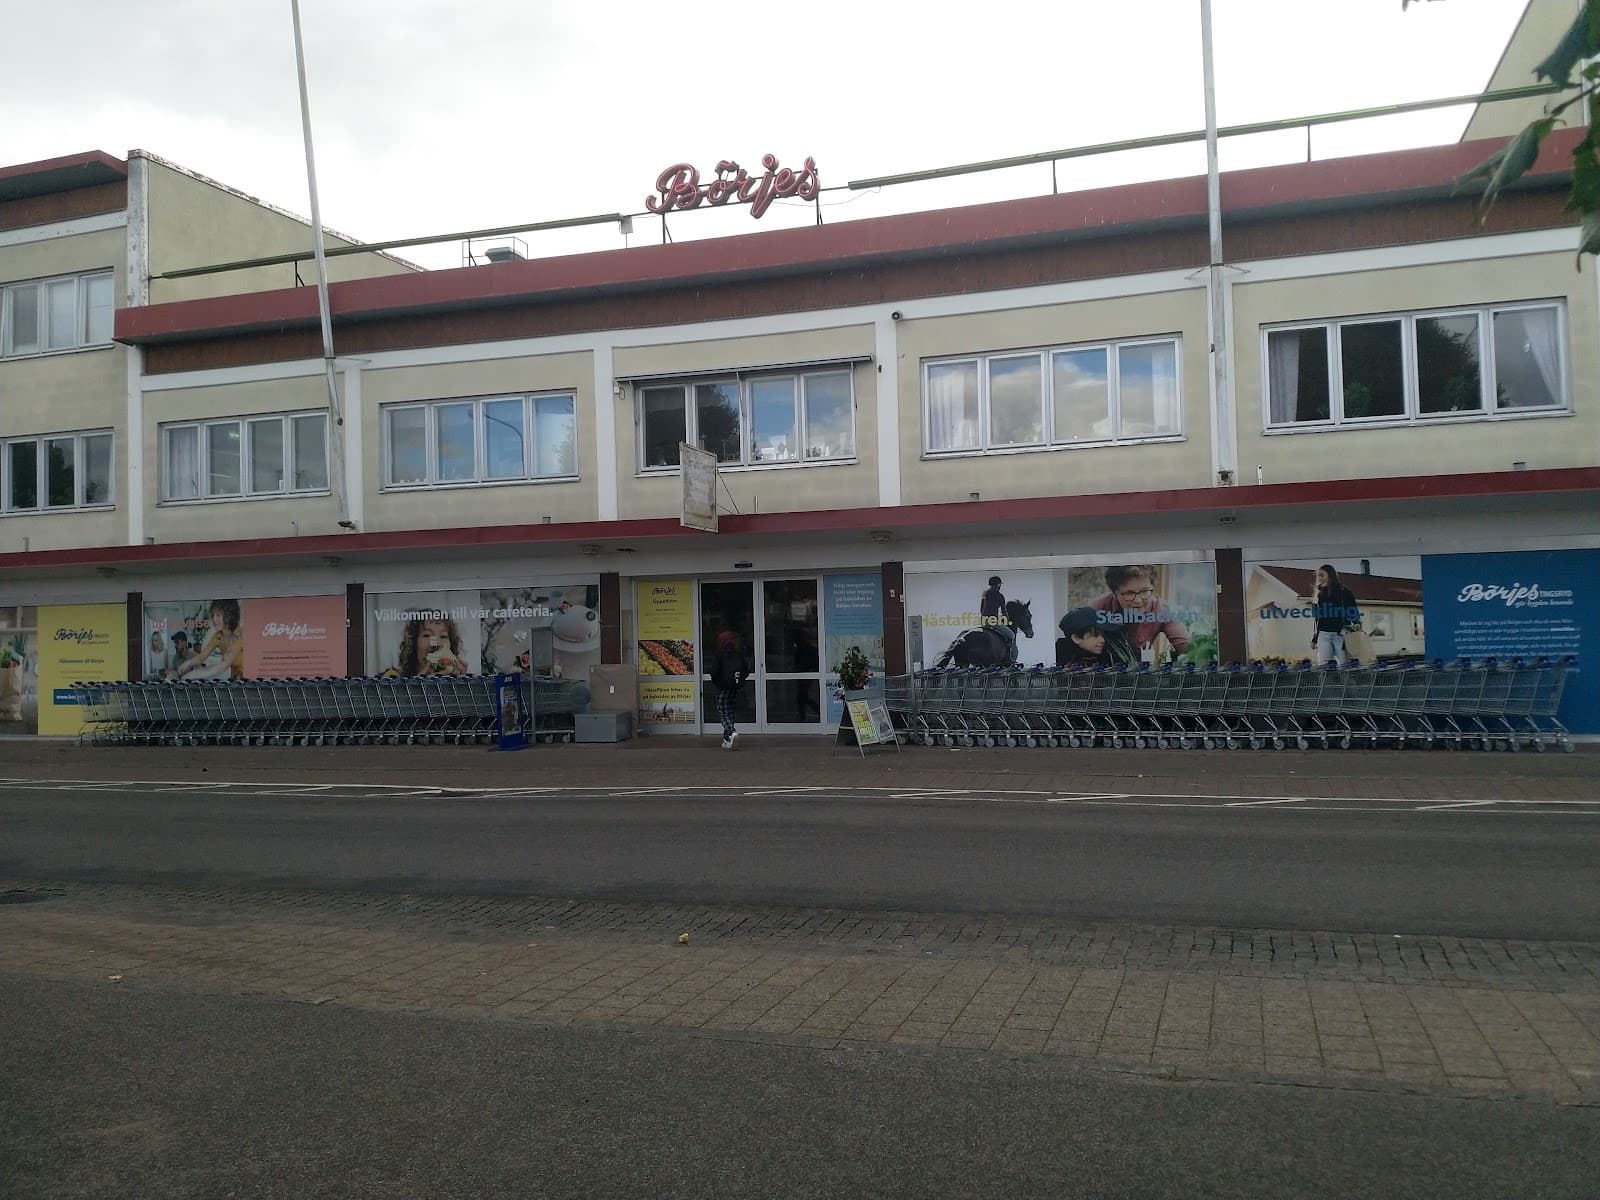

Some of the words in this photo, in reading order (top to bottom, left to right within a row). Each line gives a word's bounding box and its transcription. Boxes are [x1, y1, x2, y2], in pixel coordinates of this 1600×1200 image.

[646, 153, 820, 219] Börjes
[1457, 582, 1539, 606] Börjes
[374, 608, 449, 622] Välkommen
[451, 605, 467, 620] till
[469, 606, 490, 619] vår
[492, 603, 554, 619] cafeteria.
[1260, 601, 1365, 624] utveckling.
[54, 627, 93, 644] Börjes
[262, 621, 308, 640] Börjes
